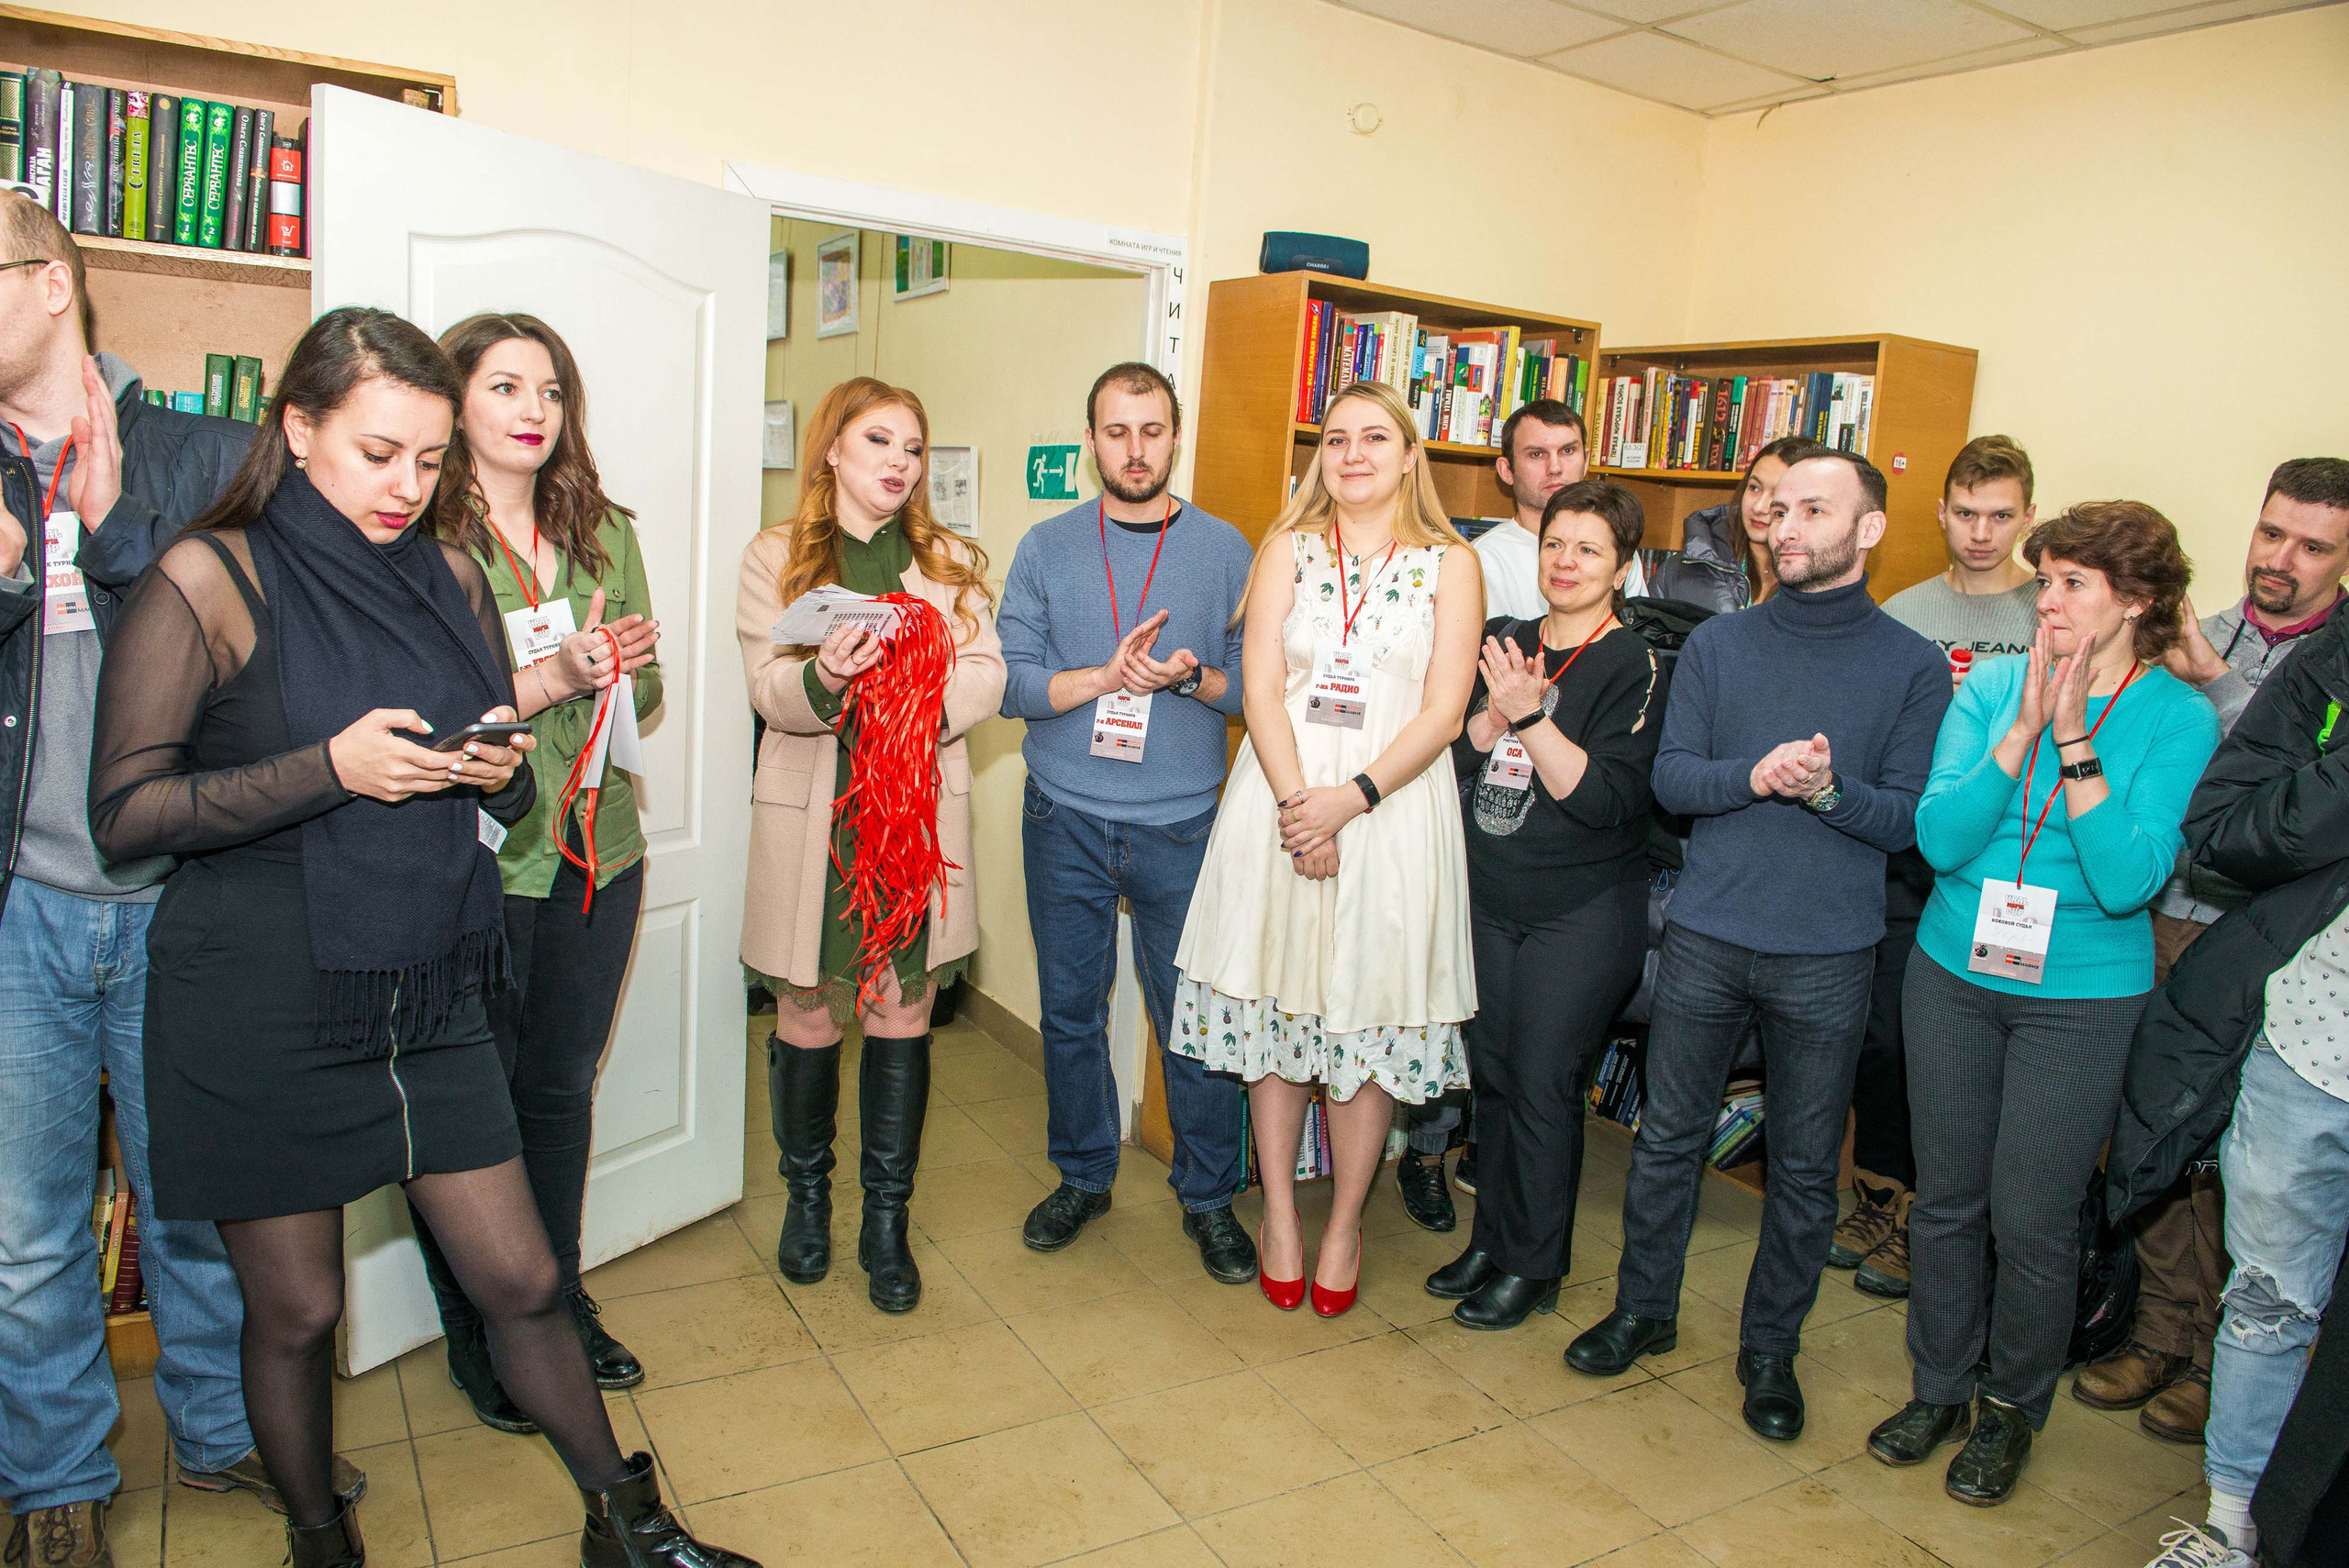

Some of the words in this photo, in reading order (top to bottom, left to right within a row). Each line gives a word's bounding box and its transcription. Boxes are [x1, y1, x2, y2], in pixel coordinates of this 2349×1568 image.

[239, 115, 250, 139] Ольга
[29, 155, 38, 184] АНСУАЗА
[36, 147, 52, 188] АГАН
[128, 131, 144, 191] СЕВЕЛА
[236, 139, 248, 186] Славникова
[183, 139, 198, 206] СЕРВАНТЕС
[208, 143, 225, 210] СЕРВАНТЕС
[208, 226, 215, 235] 2
[1108, 239, 1141, 250] КОМНАТА
[1141, 244, 1152, 252] ИГР
[1158, 247, 1182, 257] ЧТЕНИЯ
[1310, 315, 1319, 339] ЗЕМЛИ
[1308, 340, 1316, 372] ЗАГАДКИ
[1341, 346, 1353, 389] МАТЕМАТИ
[1443, 389, 1453, 412] ГОРОДА
[1616, 384, 1624, 405] ВОЙНА
[1714, 389, 1729, 422] 1612
[1442, 415, 1450, 430] МИРА
[1613, 406, 1621, 435] МИРОВАЯ
[1592, 413, 1601, 450] ПИРАТЫ
[1610, 437, 1619, 458] ПЕРВАЯ
[1709, 443, 1720, 466] ГОД
[1895, 459, 1905, 467] 16+
[46, 528, 62, 539] AL
[528, 616, 551, 628] URAL
[534, 629, 551, 640] CUP
[1333, 651, 1353, 660] URAL
[1965, 641, 2031, 654] JEAN
[1330, 683, 1360, 695] РАДИО
[1105, 717, 1143, 730] АРСЕНАЛ
[1506, 747, 1523, 759] ОСА
[2005, 894, 2030, 906] URAL
[1991, 917, 2015, 926] БОКОВОЙ
[2006, 907, 2025, 917] CUP
